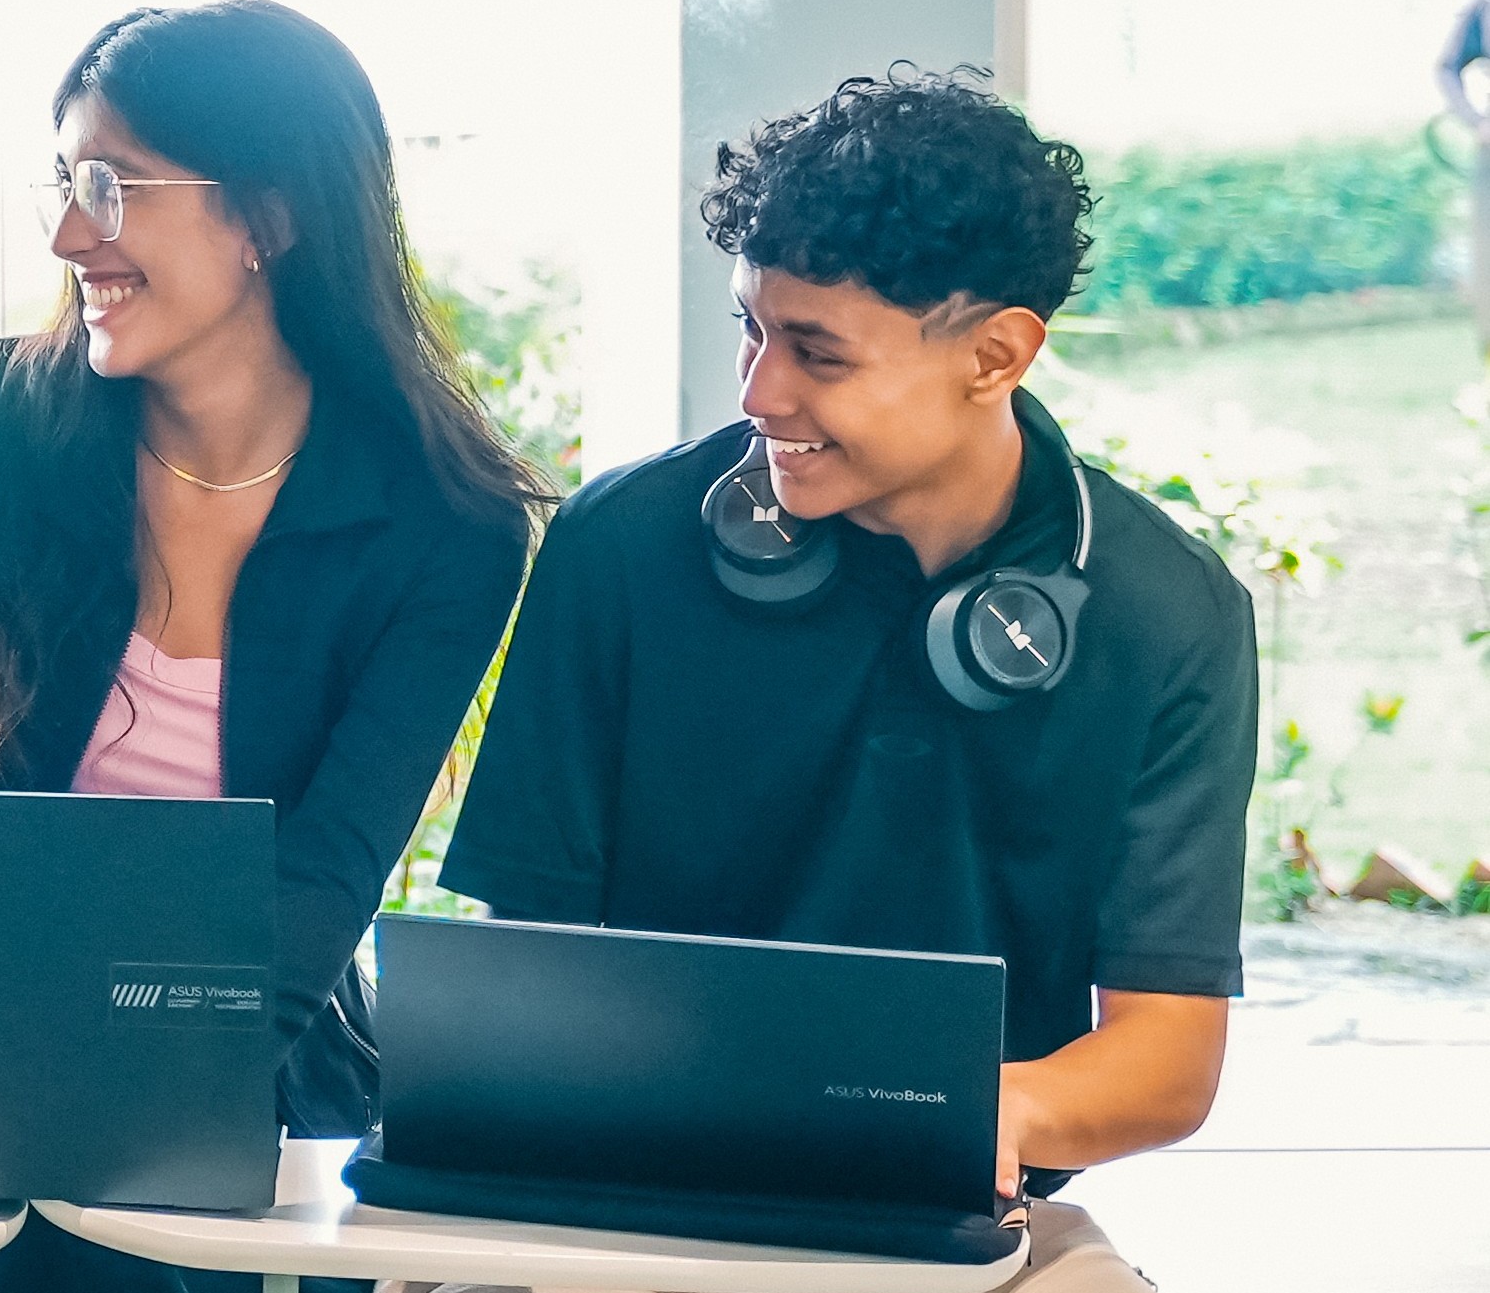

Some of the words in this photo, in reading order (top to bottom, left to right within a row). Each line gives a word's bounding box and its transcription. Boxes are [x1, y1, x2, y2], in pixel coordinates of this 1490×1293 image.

[168, 986, 202, 997] ASUS
[205, 986, 261, 998] Vivobook
[824, 1086, 864, 1099] ASUS
[868, 1088, 947, 1104] VivoBook
